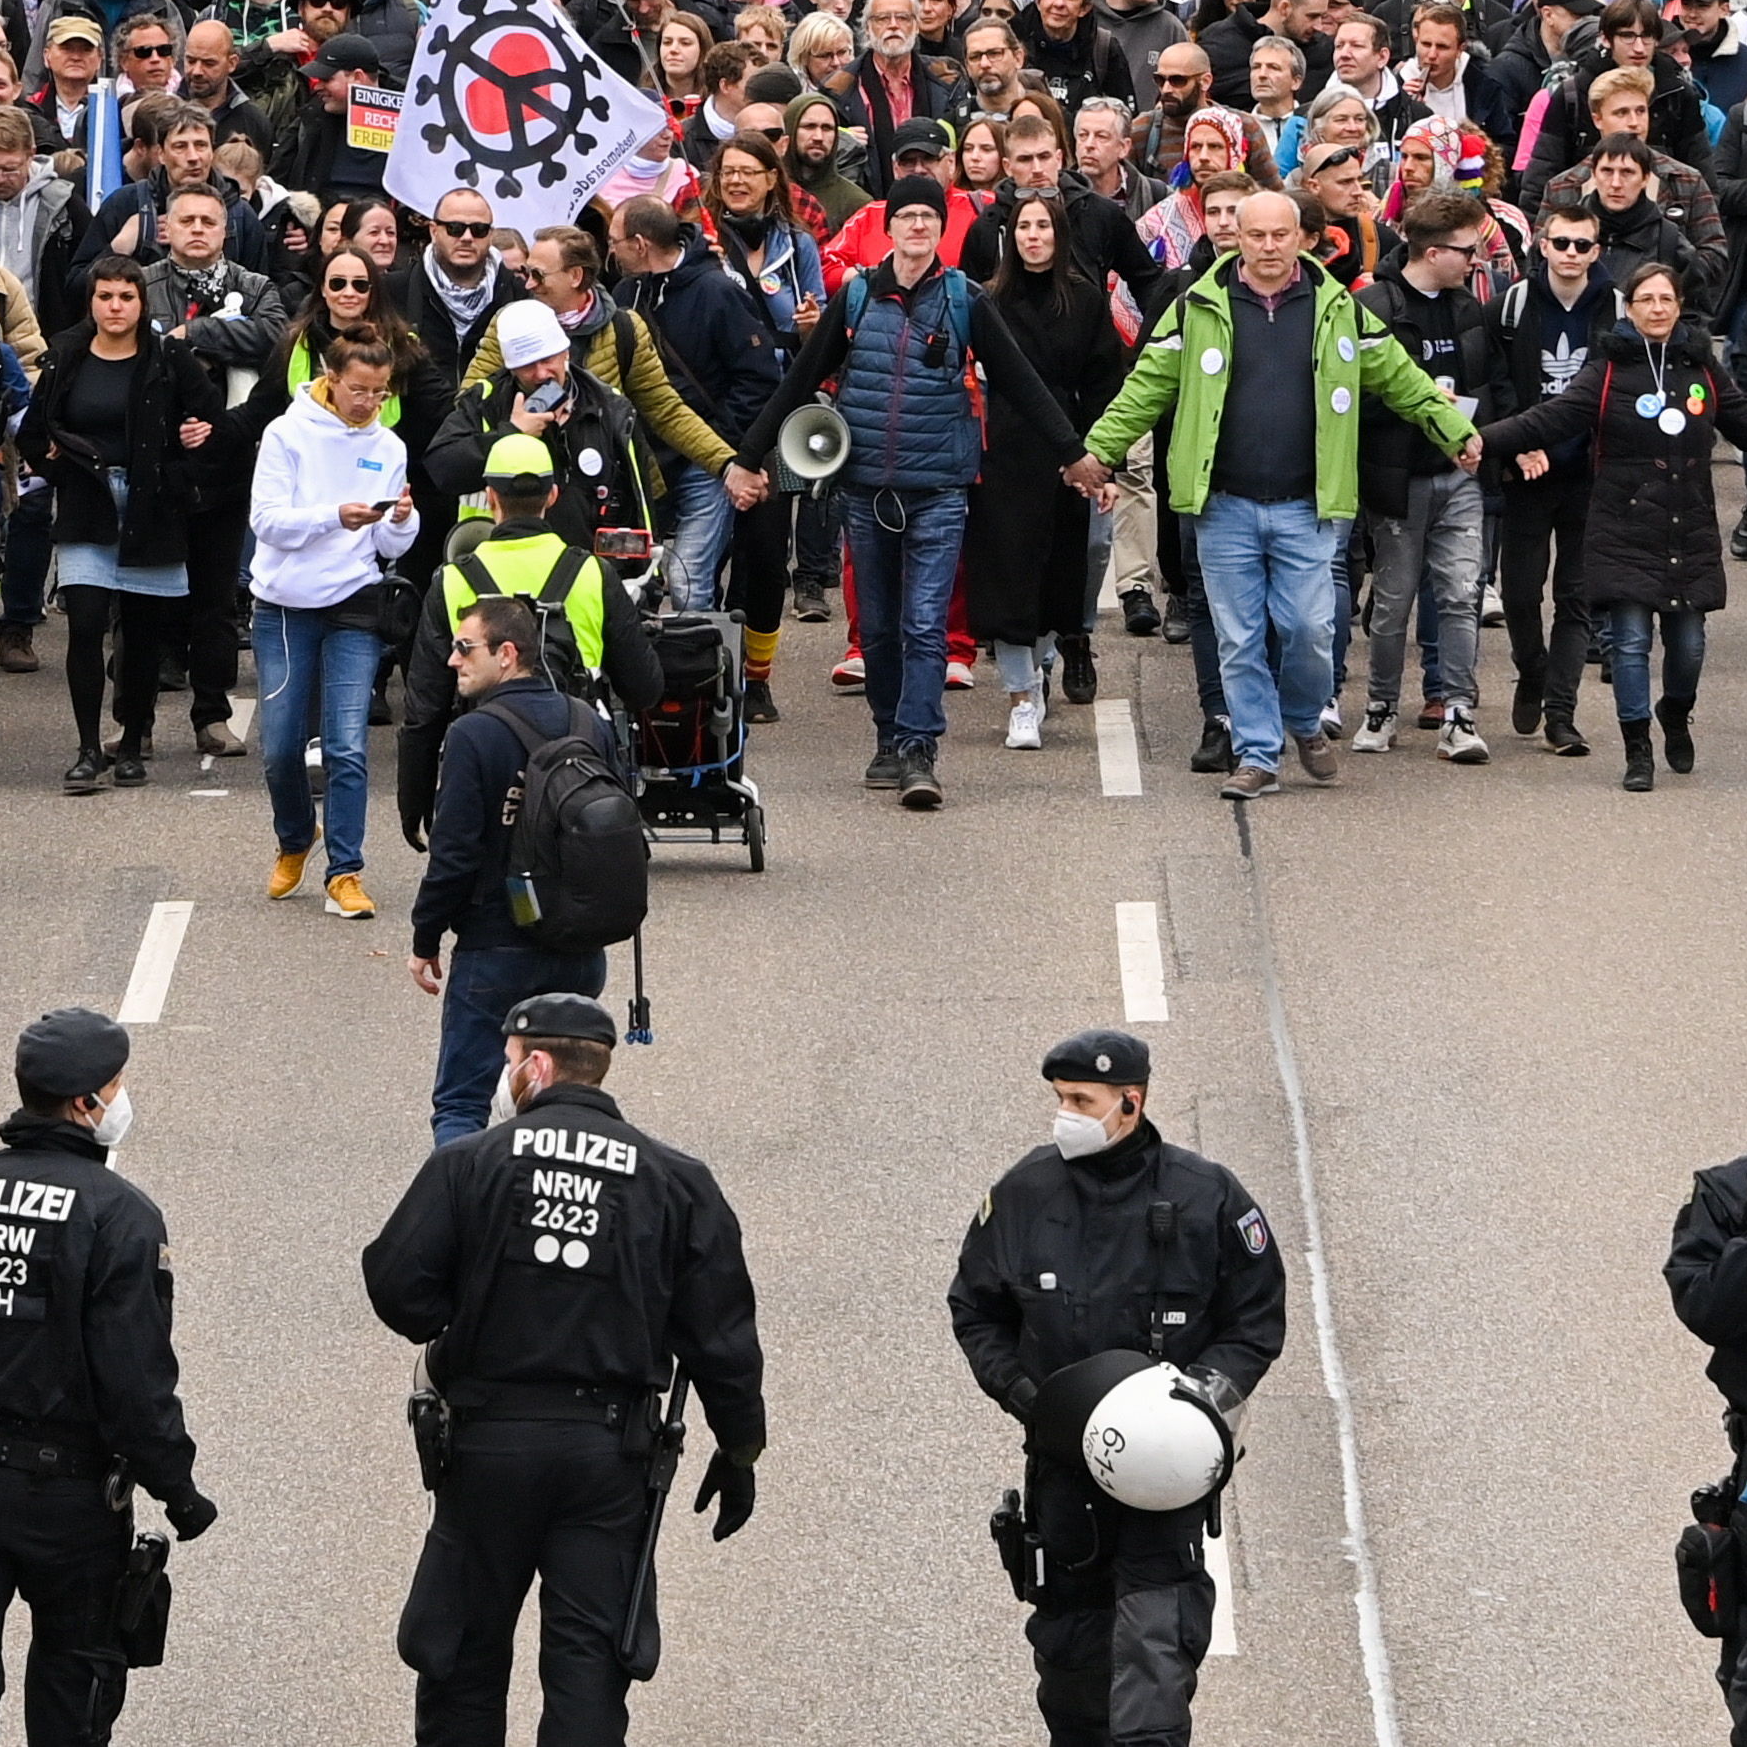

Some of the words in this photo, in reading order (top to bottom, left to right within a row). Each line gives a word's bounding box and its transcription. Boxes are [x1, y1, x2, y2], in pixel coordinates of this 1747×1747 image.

[354, 87, 403, 108] EINIGKE
[364, 111, 397, 130] RECH
[354, 130, 394, 148] FREIH
[512, 1127, 637, 1175] POLIZEI
[531, 1169, 603, 1205] NRW
[530, 1199, 600, 1237] 2623
